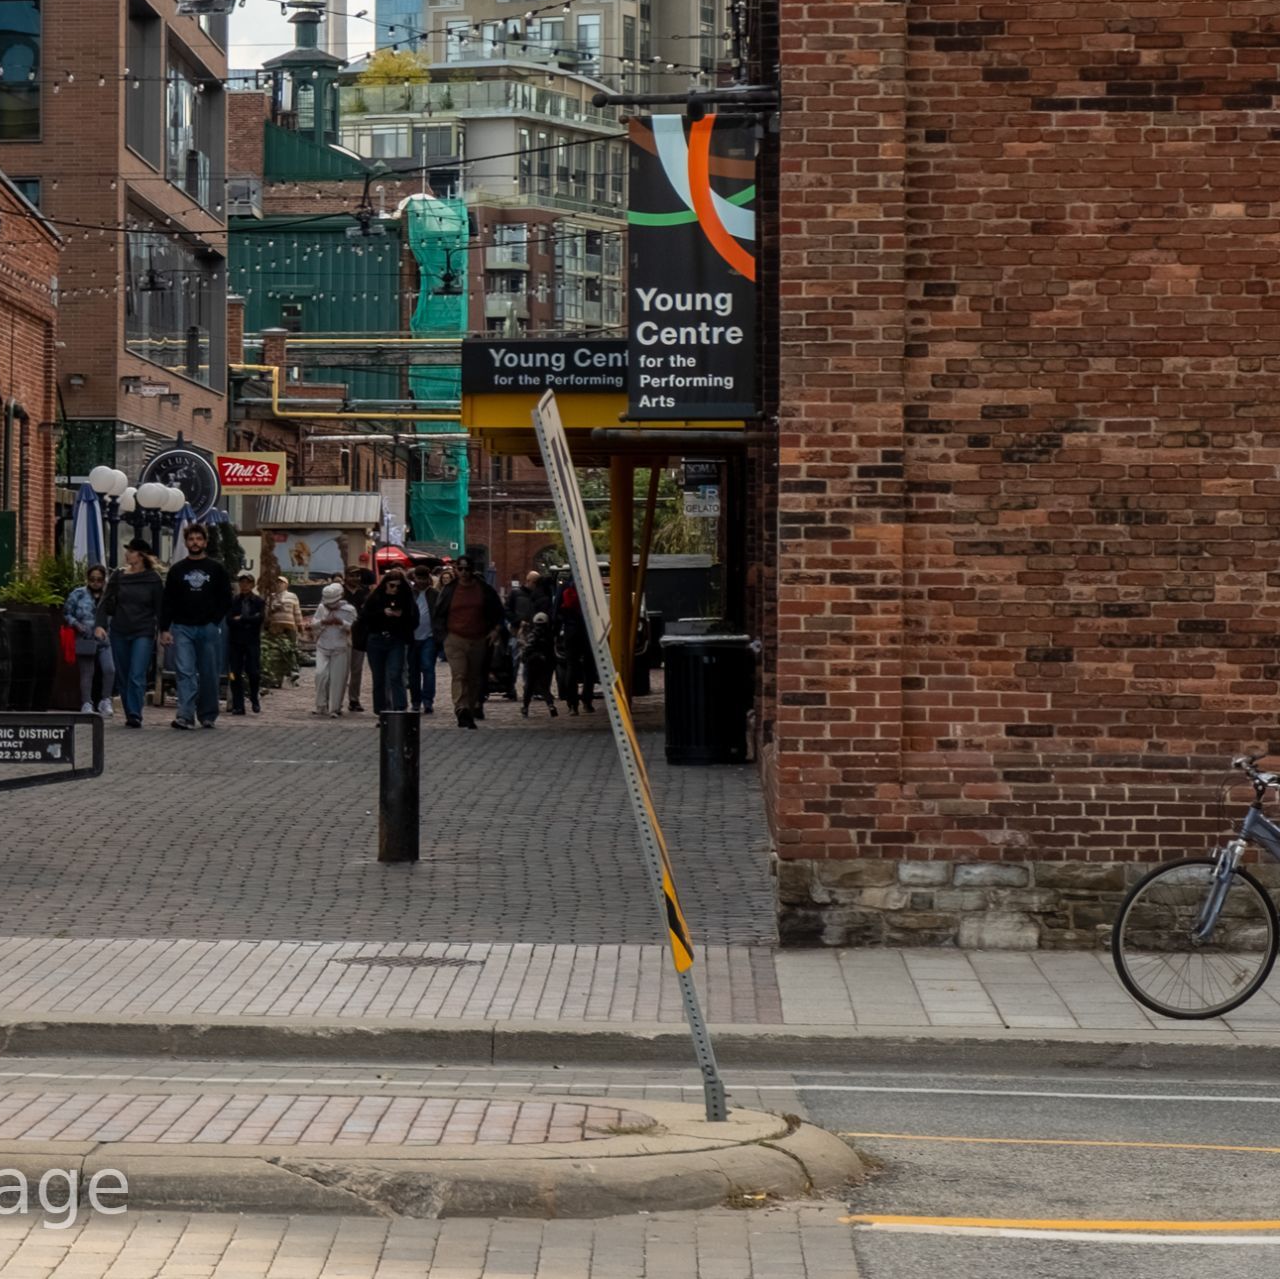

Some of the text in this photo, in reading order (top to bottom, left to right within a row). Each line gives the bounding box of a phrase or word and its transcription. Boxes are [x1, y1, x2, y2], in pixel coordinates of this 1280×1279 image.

[636, 287, 733, 316] Young
[636, 321, 744, 345] Centre
[489, 348, 630, 371] Young Cent
[639, 354, 696, 368] for the
[494, 374, 624, 388] for the Performing
[640, 374, 734, 390] Performing
[639, 395, 676, 408] Arts
[222, 462, 253, 477] Mill
[686, 463, 718, 473] SOMA
[685, 504, 720, 513] GELATO
[19, 729, 65, 739] DISTRICT
